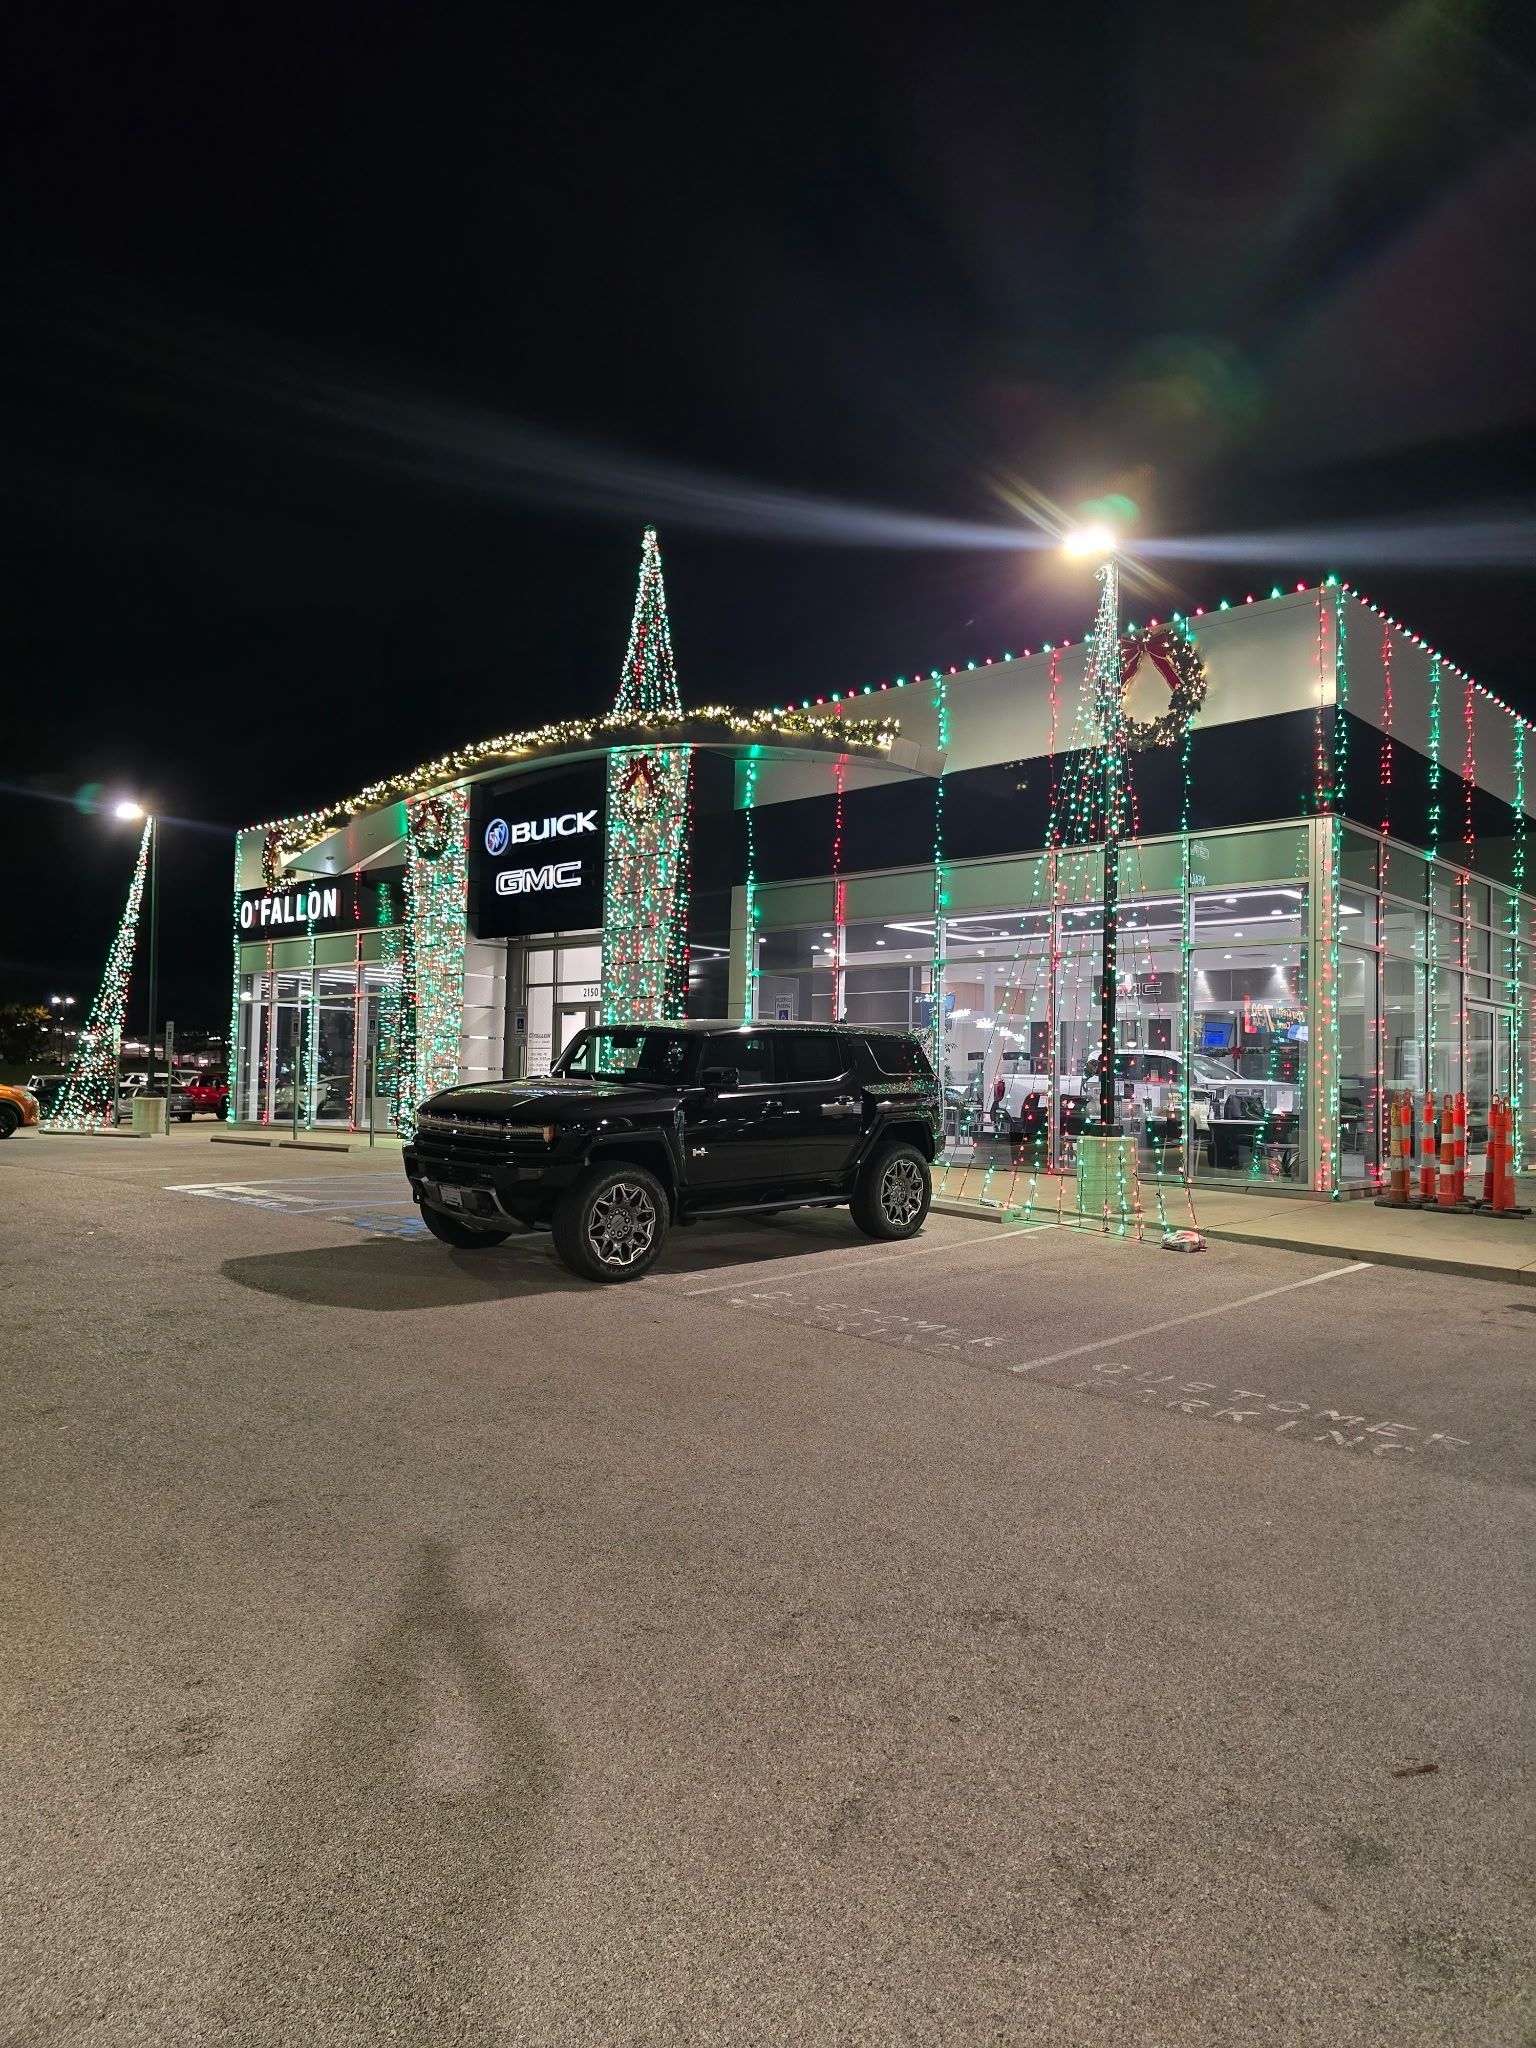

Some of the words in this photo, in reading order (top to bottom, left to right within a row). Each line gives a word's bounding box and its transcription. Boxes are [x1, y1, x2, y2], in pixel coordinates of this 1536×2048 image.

[512, 809, 598, 845] BUICK
[495, 860, 582, 896] GMC
[240, 888, 337, 929] O'FALLON
[583, 987, 599, 997] 2150
